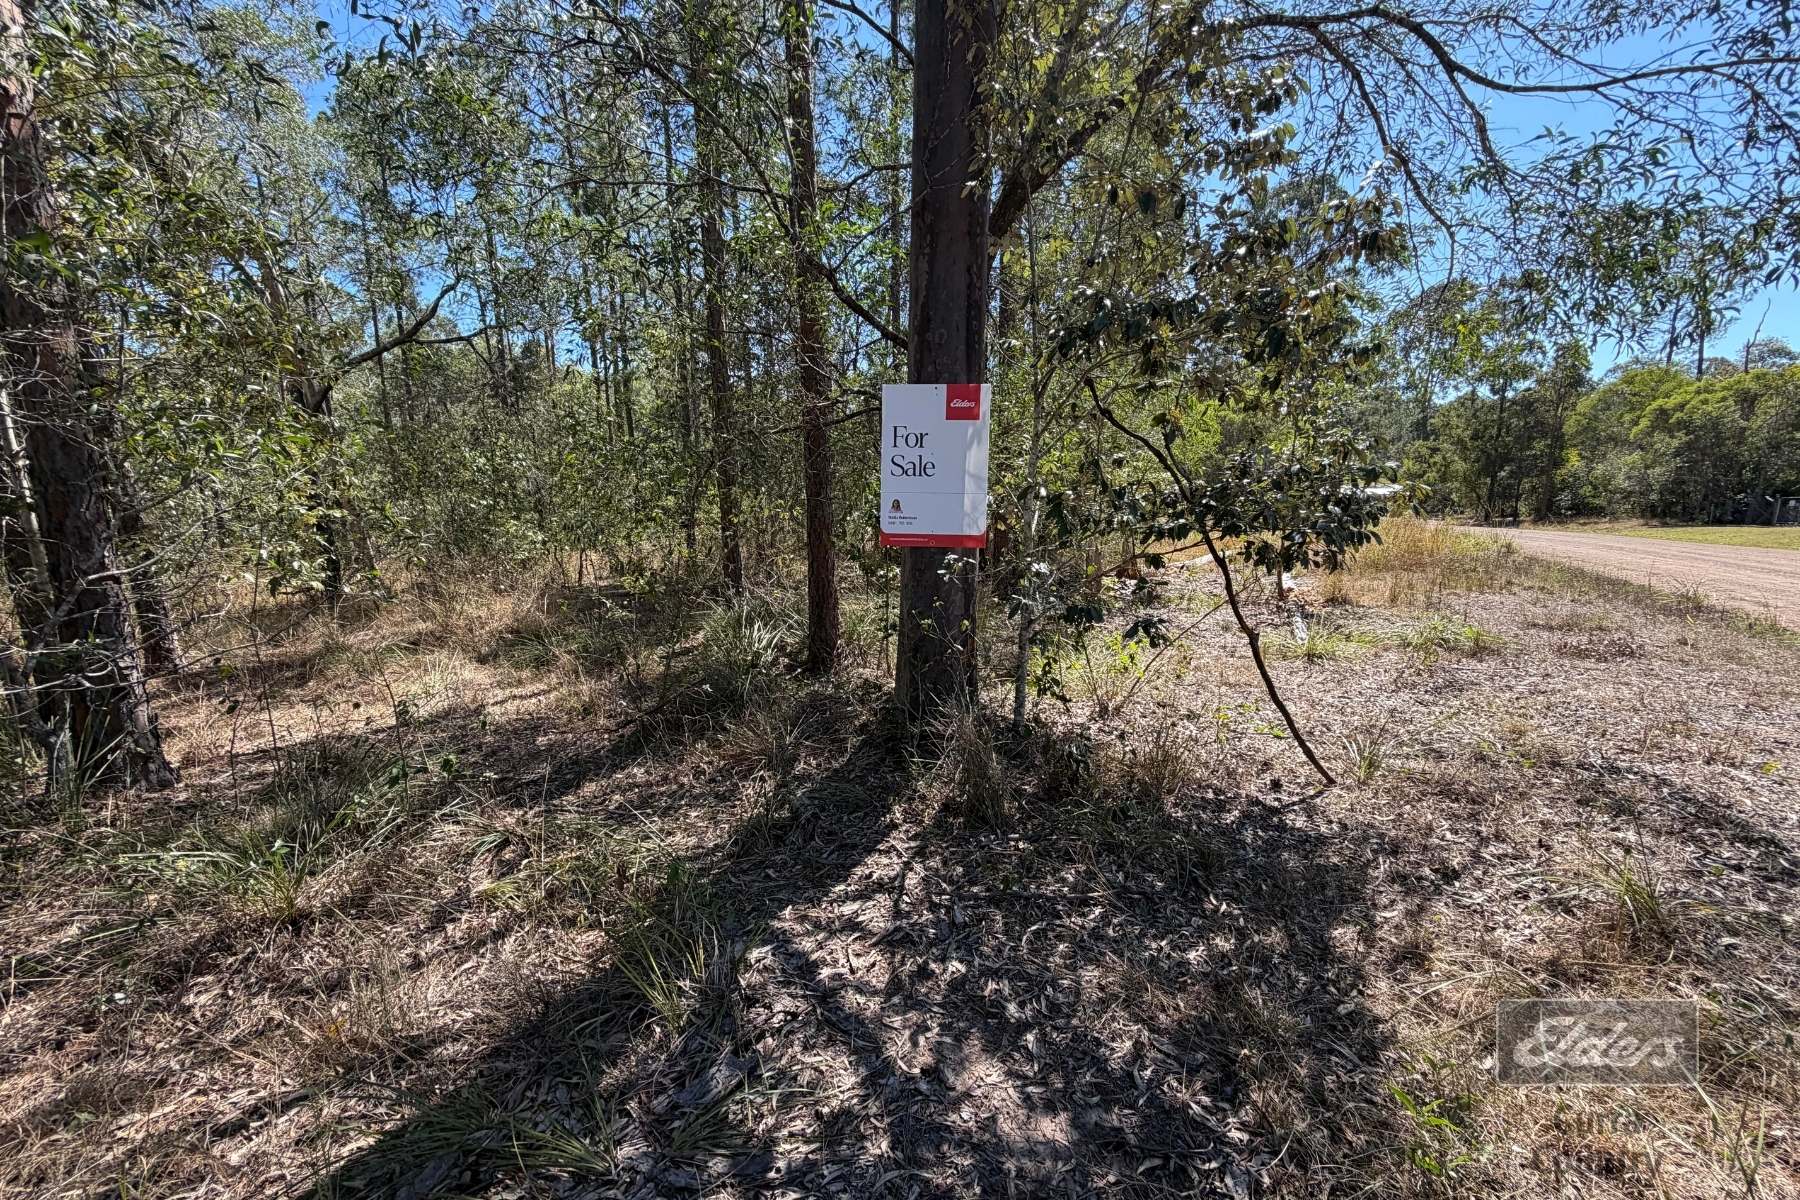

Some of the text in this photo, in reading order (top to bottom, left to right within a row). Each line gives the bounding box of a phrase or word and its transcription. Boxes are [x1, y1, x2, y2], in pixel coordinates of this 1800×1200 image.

[950, 398, 977, 408] Elders
[891, 425, 929, 448] For
[890, 454, 936, 477] Sale
